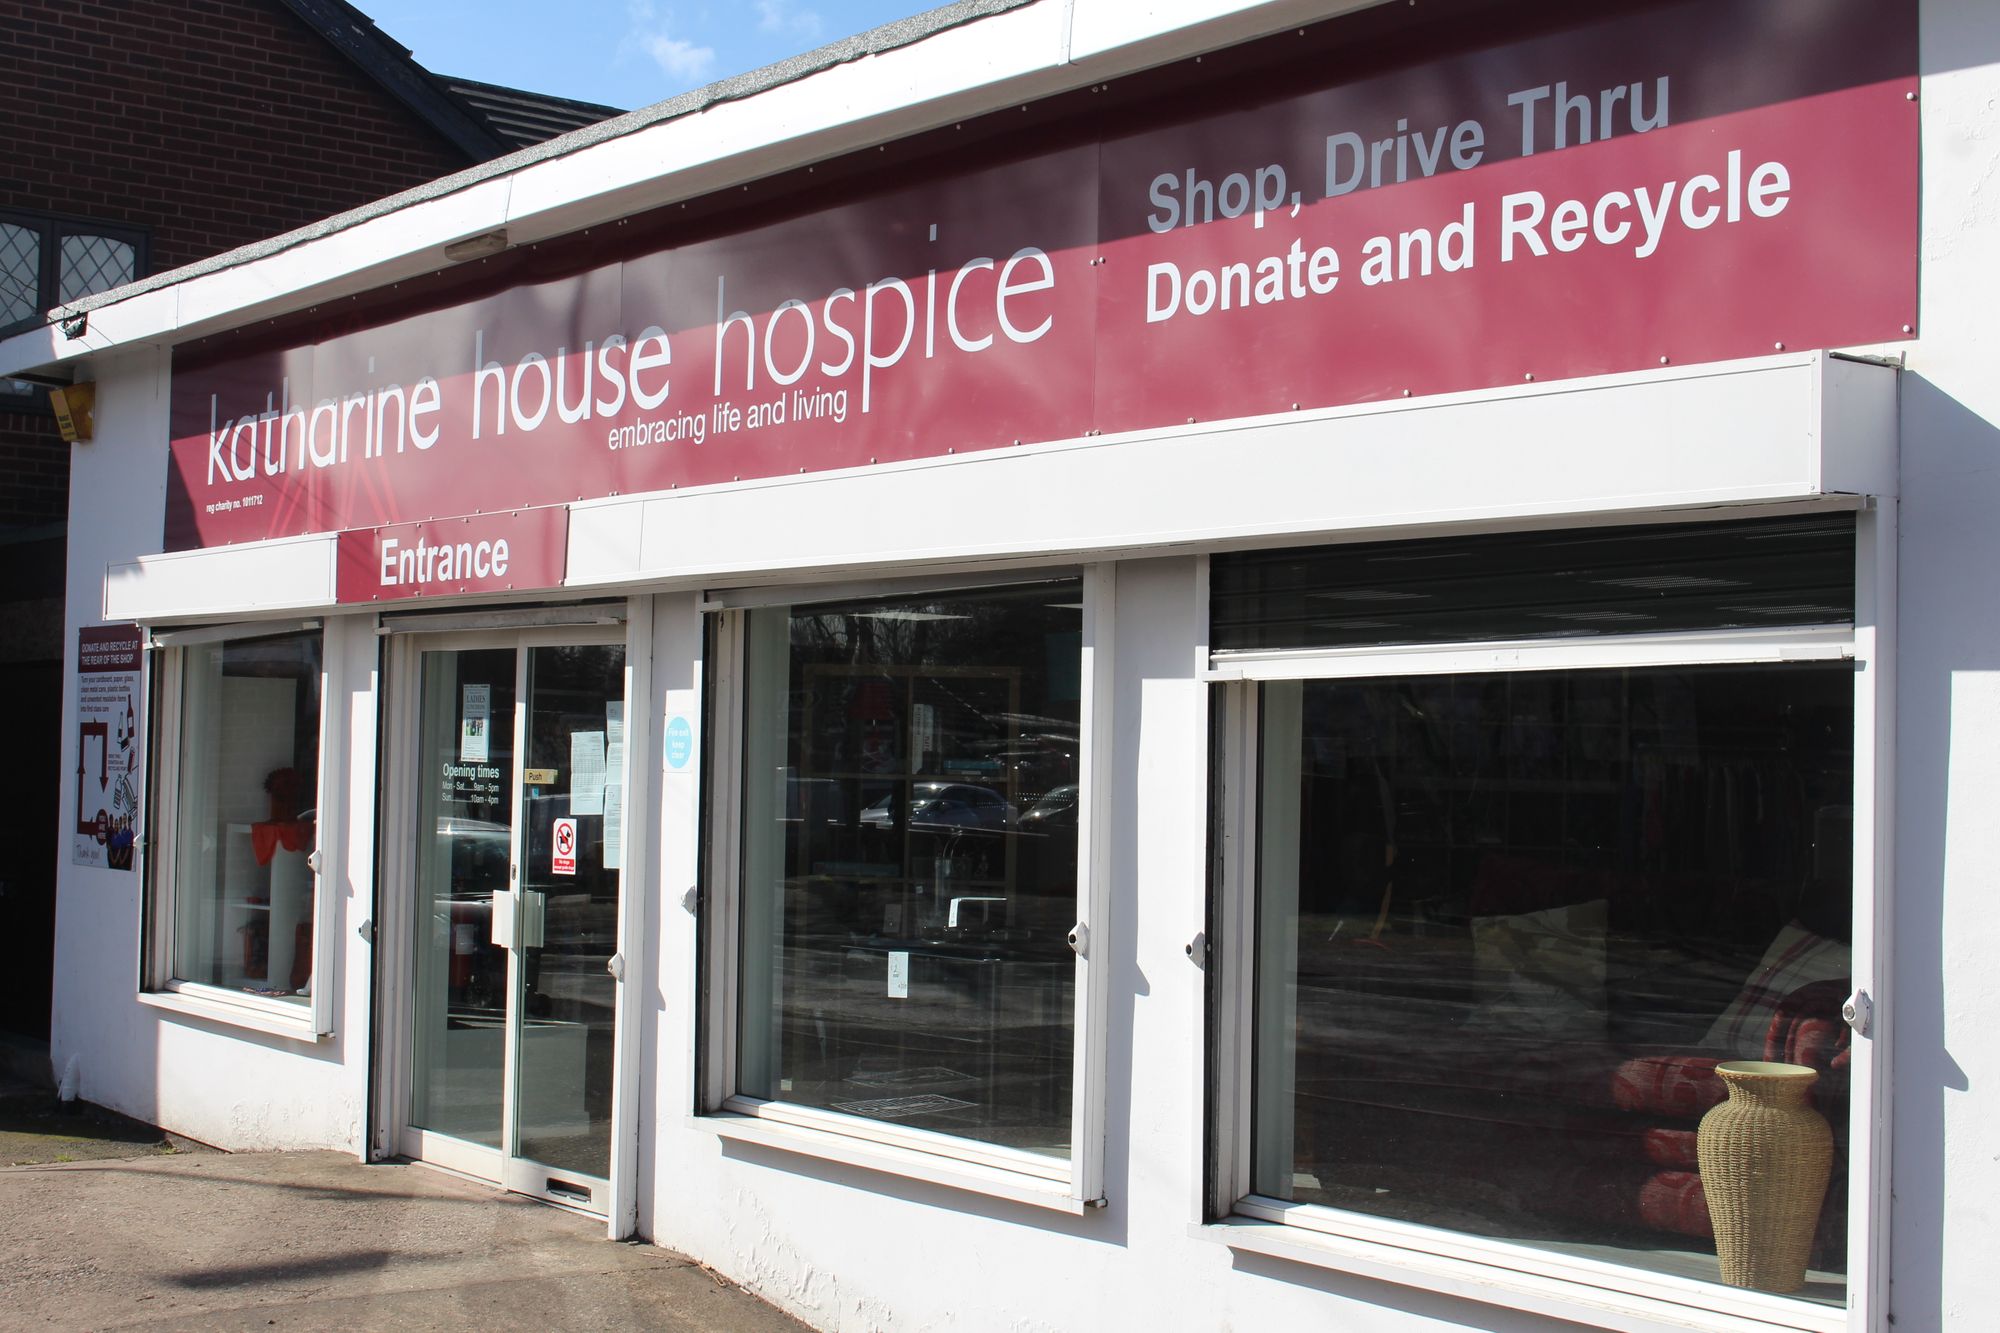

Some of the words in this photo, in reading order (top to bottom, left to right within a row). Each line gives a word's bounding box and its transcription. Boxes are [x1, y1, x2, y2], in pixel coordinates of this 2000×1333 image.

[1148, 160, 1301, 233] Shop,
[1325, 118, 1485, 198] Drive
[1507, 75, 1670, 157] Thru
[1147, 238, 1340, 323] Donate
[1360, 202, 1475, 286] and
[1500, 150, 1791, 262] Recycle
[207, 356, 441, 486] katharine
[472, 329, 671, 439] house
[714, 223, 1055, 413] hospice
[608, 411, 706, 450] embracing
[712, 403, 741, 434] life
[747, 393, 786, 428] and
[793, 386, 848, 423] living
[380, 538, 509, 587] Entrance
[442, 763, 476, 781] Opening
[477, 764, 500, 779] times
[528, 772, 543, 782] Push
